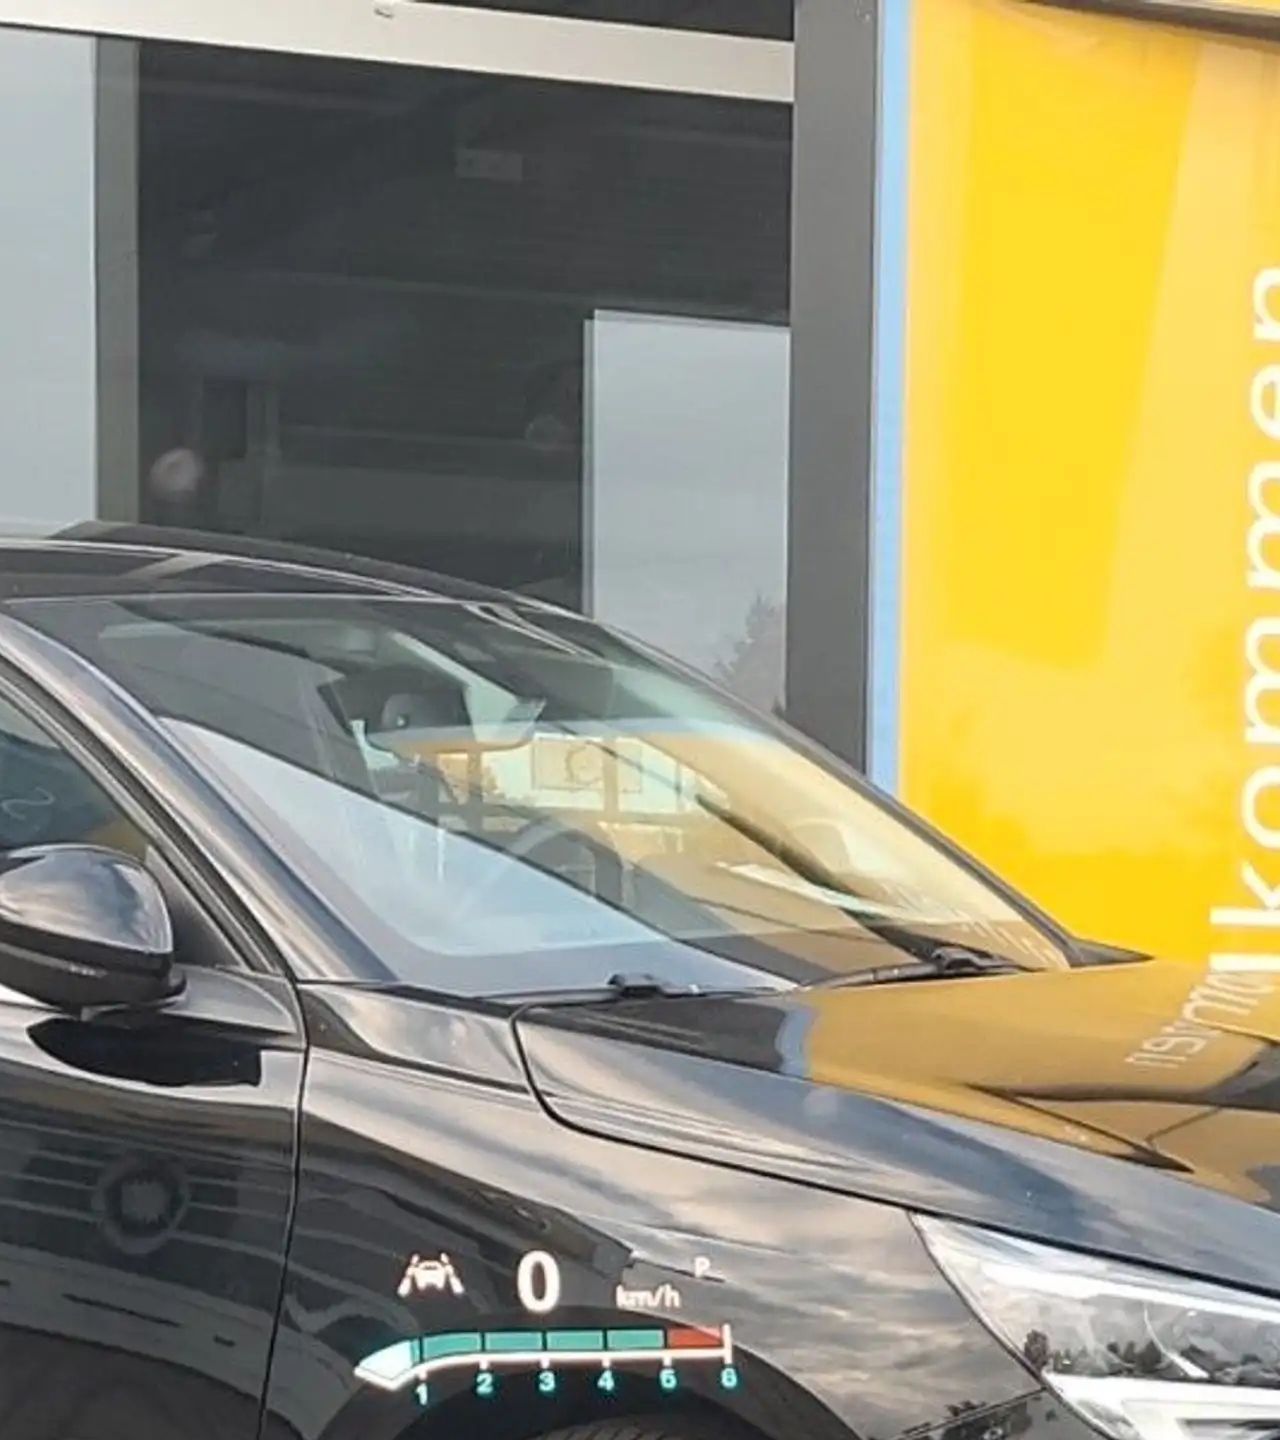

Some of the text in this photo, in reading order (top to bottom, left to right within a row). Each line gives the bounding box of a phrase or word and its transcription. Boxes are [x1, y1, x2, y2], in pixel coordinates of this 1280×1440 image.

[517, 1248, 561, 1313] 0
[615, 1283, 681, 1310] km/h
[415, 1384, 428, 1405] 1
[476, 1374, 494, 1394] 2
[538, 1372, 556, 1391] 3
[596, 1371, 615, 1392] 4
[720, 1368, 738, 1389] 6
